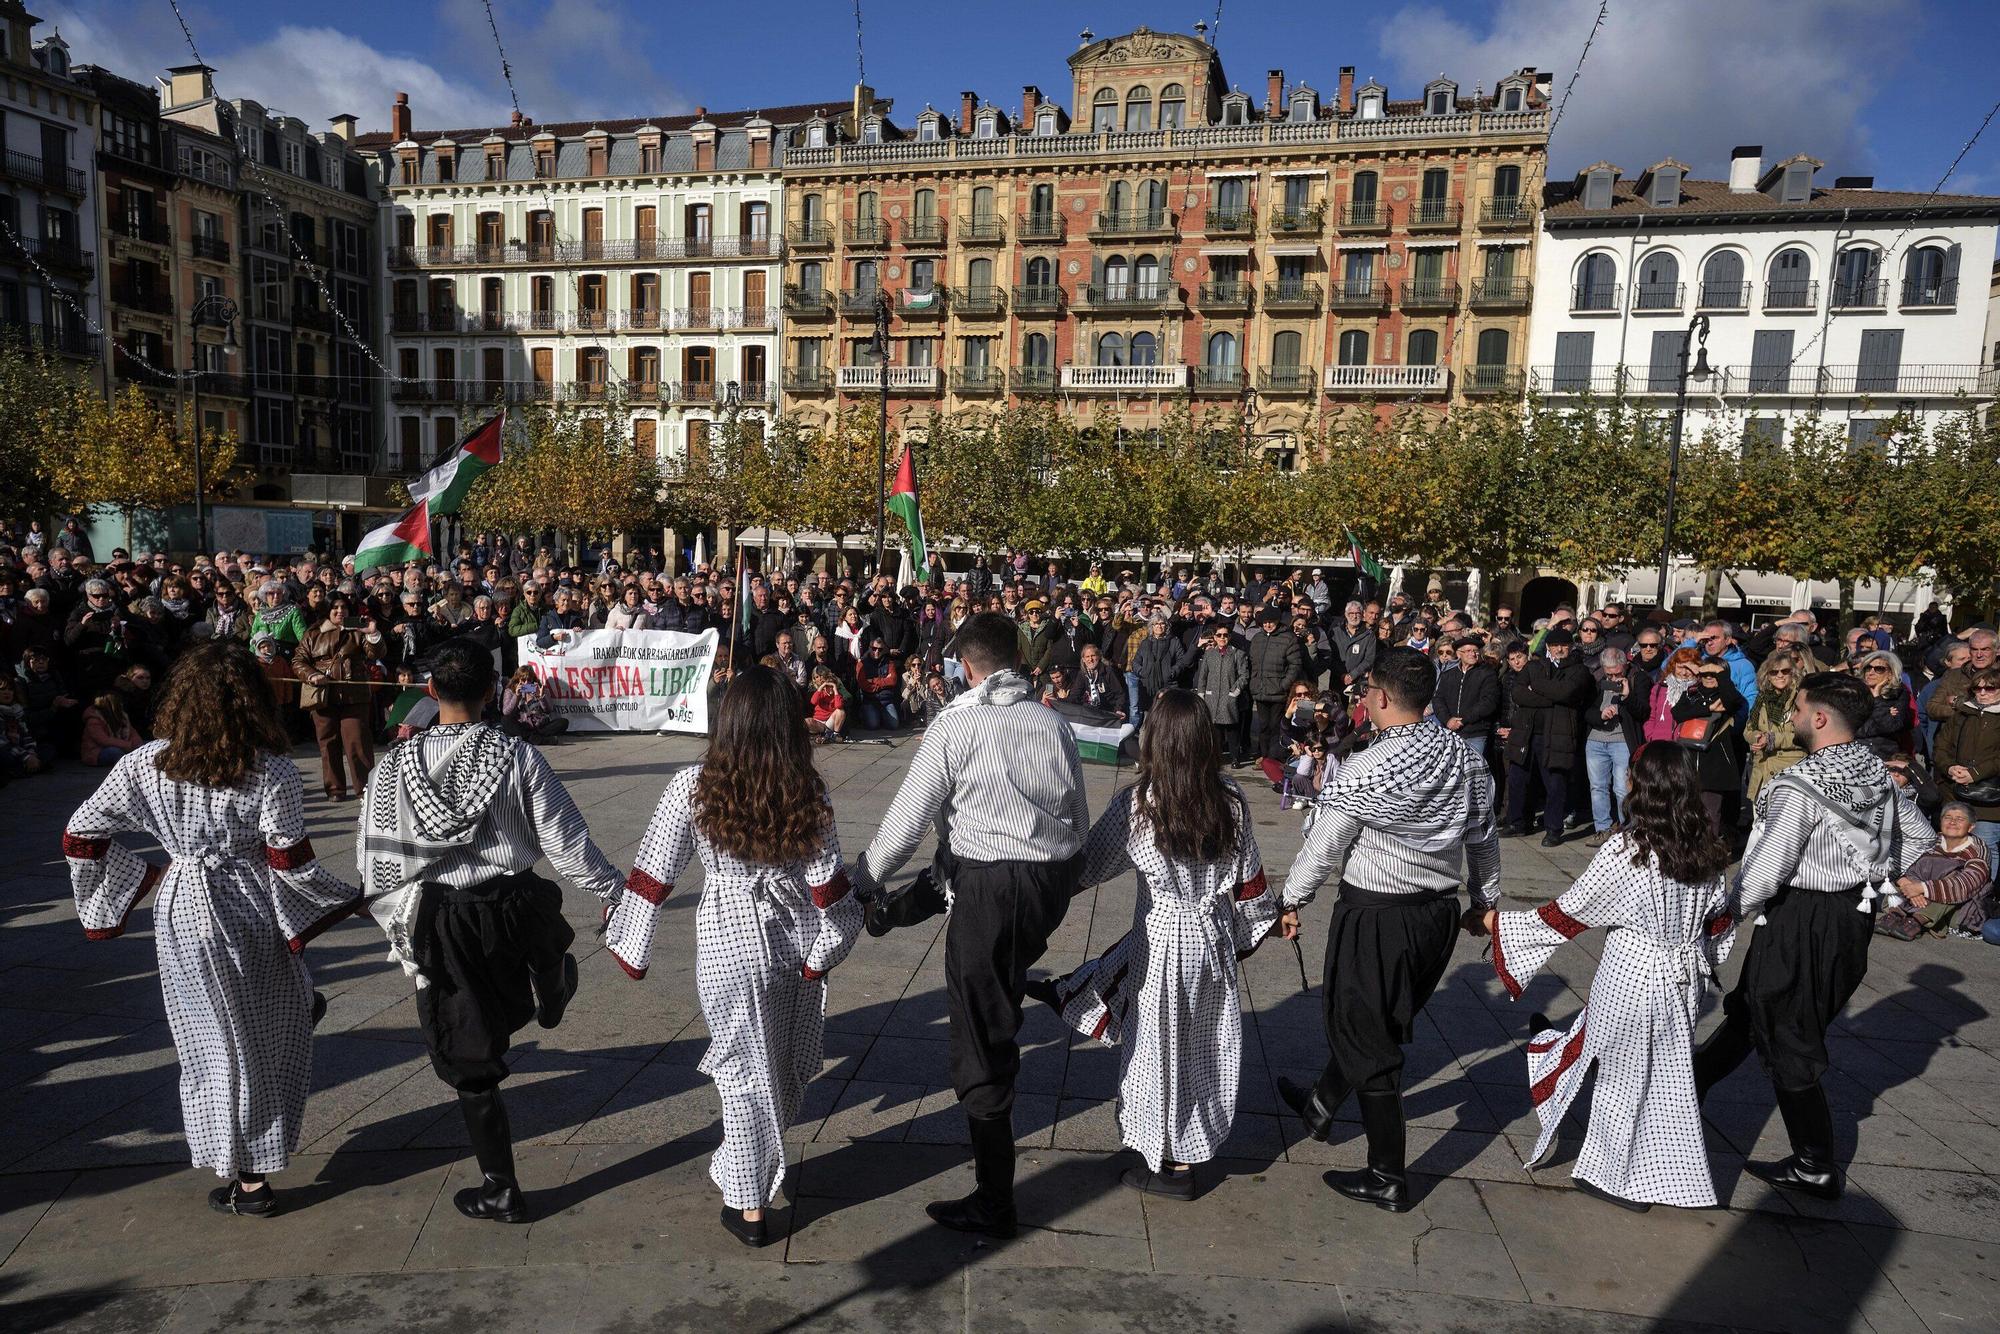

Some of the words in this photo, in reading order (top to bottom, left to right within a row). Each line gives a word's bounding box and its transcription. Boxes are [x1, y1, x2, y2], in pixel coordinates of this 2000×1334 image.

[594, 646, 637, 660] IRAKASLEOK
[650, 664, 706, 696] LIBRE
[597, 704, 606, 713] EL
